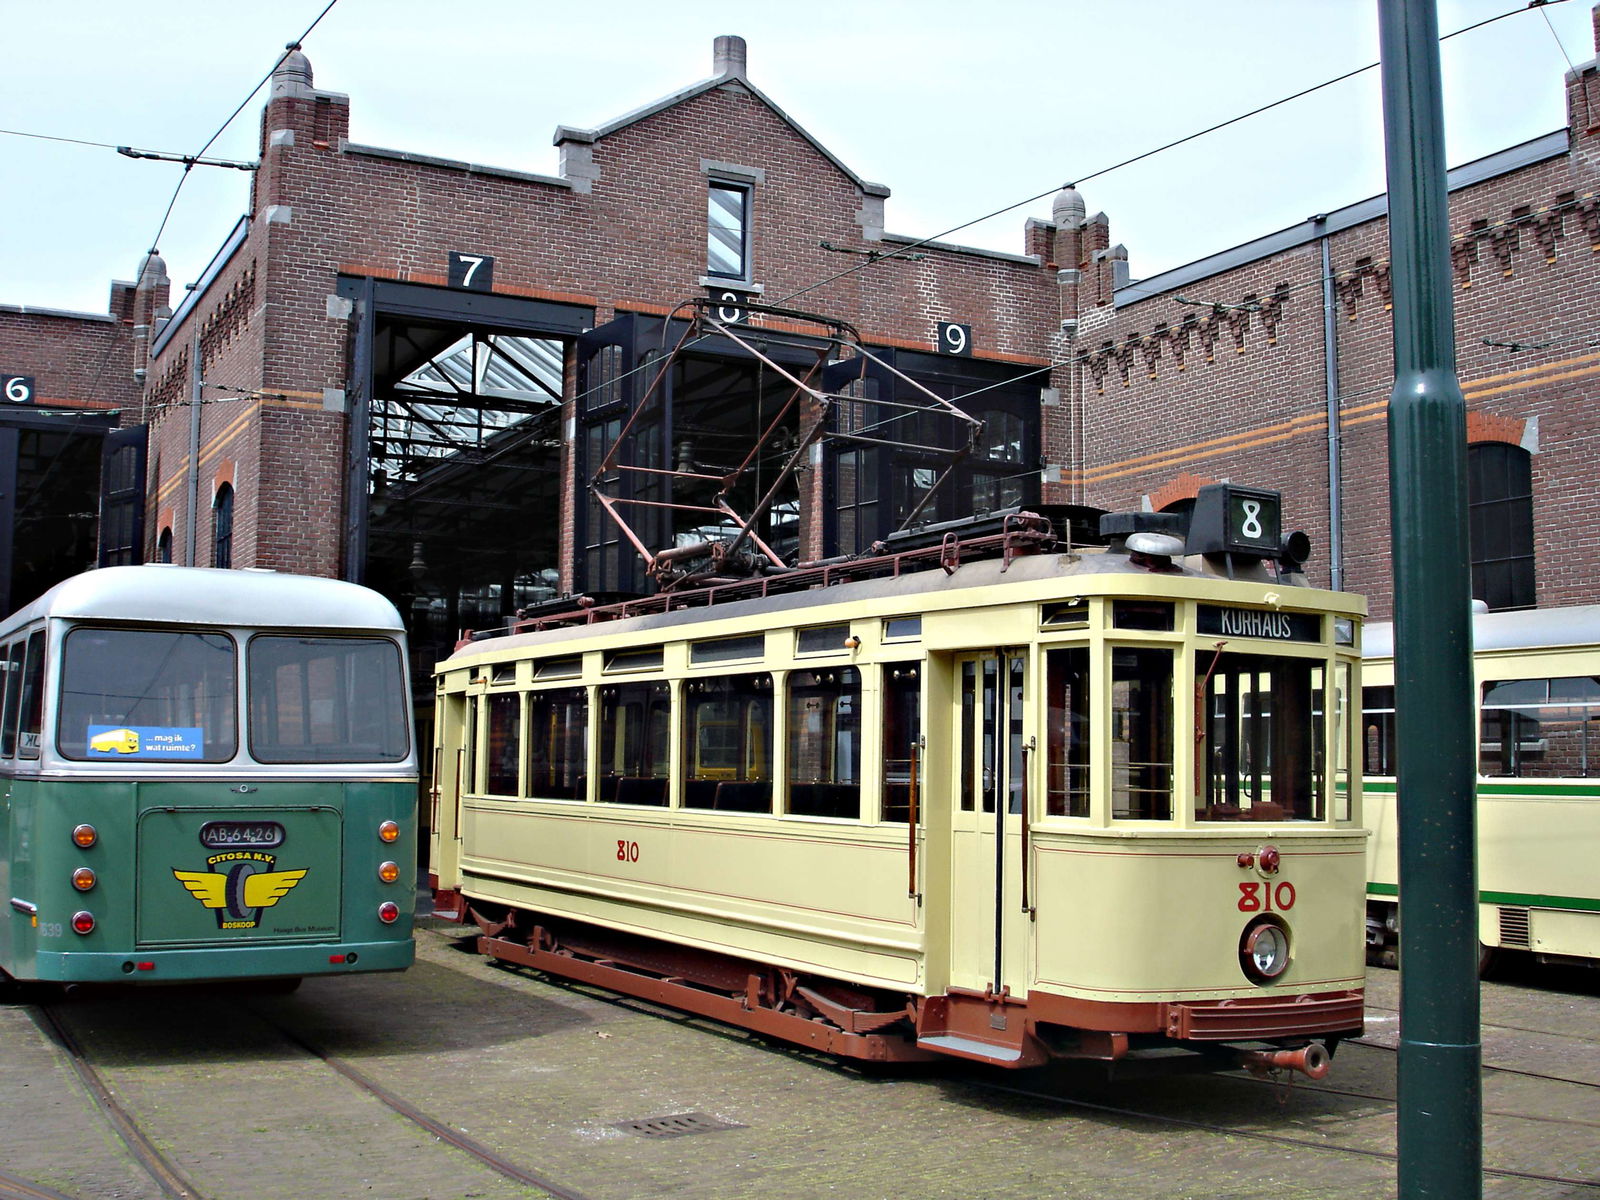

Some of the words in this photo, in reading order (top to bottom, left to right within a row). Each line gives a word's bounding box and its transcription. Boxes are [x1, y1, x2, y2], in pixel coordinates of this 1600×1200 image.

[459, 255, 484, 287] 7
[719, 292, 740, 323] 8
[946, 324, 966, 354] 9
[6, 377, 29, 402] 6
[1242, 500, 1262, 539] 8
[1221, 609, 1291, 638] KURHAUS
[145, 744, 162, 752] wat
[162, 744, 196, 752] ruimte?
[154, 735, 173, 744] mag
[174, 734, 183, 742] ik
[208, 852, 252, 864] CITOSA
[253, 852, 275, 864] N.V.
[617, 840, 639, 863] 810
[1238, 881, 1296, 912] 810
[222, 921, 256, 929] BOSKOOP
